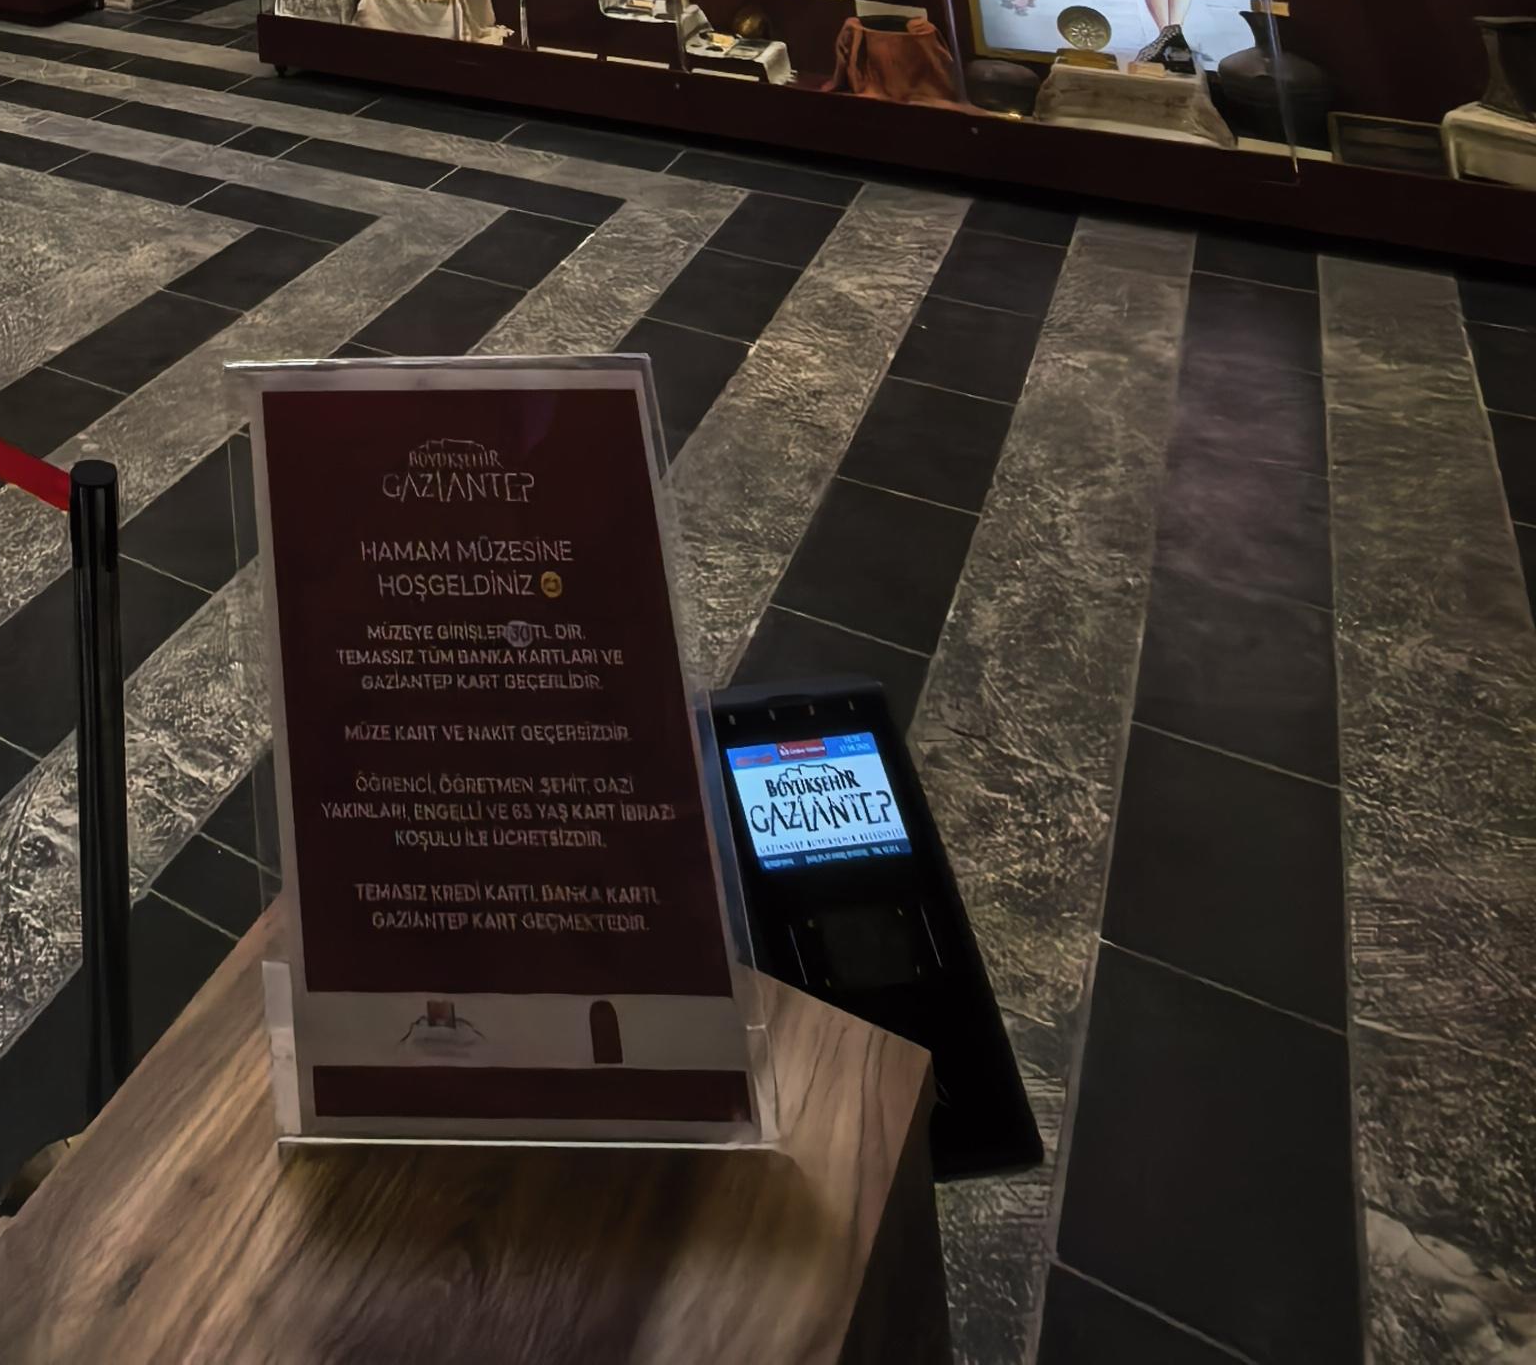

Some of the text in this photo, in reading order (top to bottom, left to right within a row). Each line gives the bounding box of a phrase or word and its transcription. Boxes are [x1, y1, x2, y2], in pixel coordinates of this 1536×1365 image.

[360, 536, 574, 562] HAMAM MÜZESİNE
[378, 569, 535, 602] HOŞGELDİNİZ
[366, 621, 434, 640] MÜZEYE
[336, 646, 624, 665] TEMASSIZ TÜM BANKA KARTLARI VE
[361, 669, 452, 690] GAZİANTEP
[457, 674, 500, 689] KART
[344, 722, 391, 741] MÜZE
[395, 725, 437, 741] KART
[441, 725, 464, 741] VE
[467, 722, 516, 741] NAKİT
[593, 775, 634, 794] GAZİ
[321, 802, 412, 821] YAKINLARI,
[414, 801, 482, 821] ENGELLİ
[486, 803, 509, 820] VE
[536, 803, 568, 822] YAŞ
[571, 804, 615, 820] KART
[394, 829, 462, 852] KOŞULU
[465, 826, 488, 847] İLE
[354, 883, 429, 901] TEMASIZ
[431, 880, 482, 902] KREDİ
[542, 885, 601, 902] BANKA
[372, 911, 468, 930] GAZİANTEP
[472, 913, 517, 930] KART
